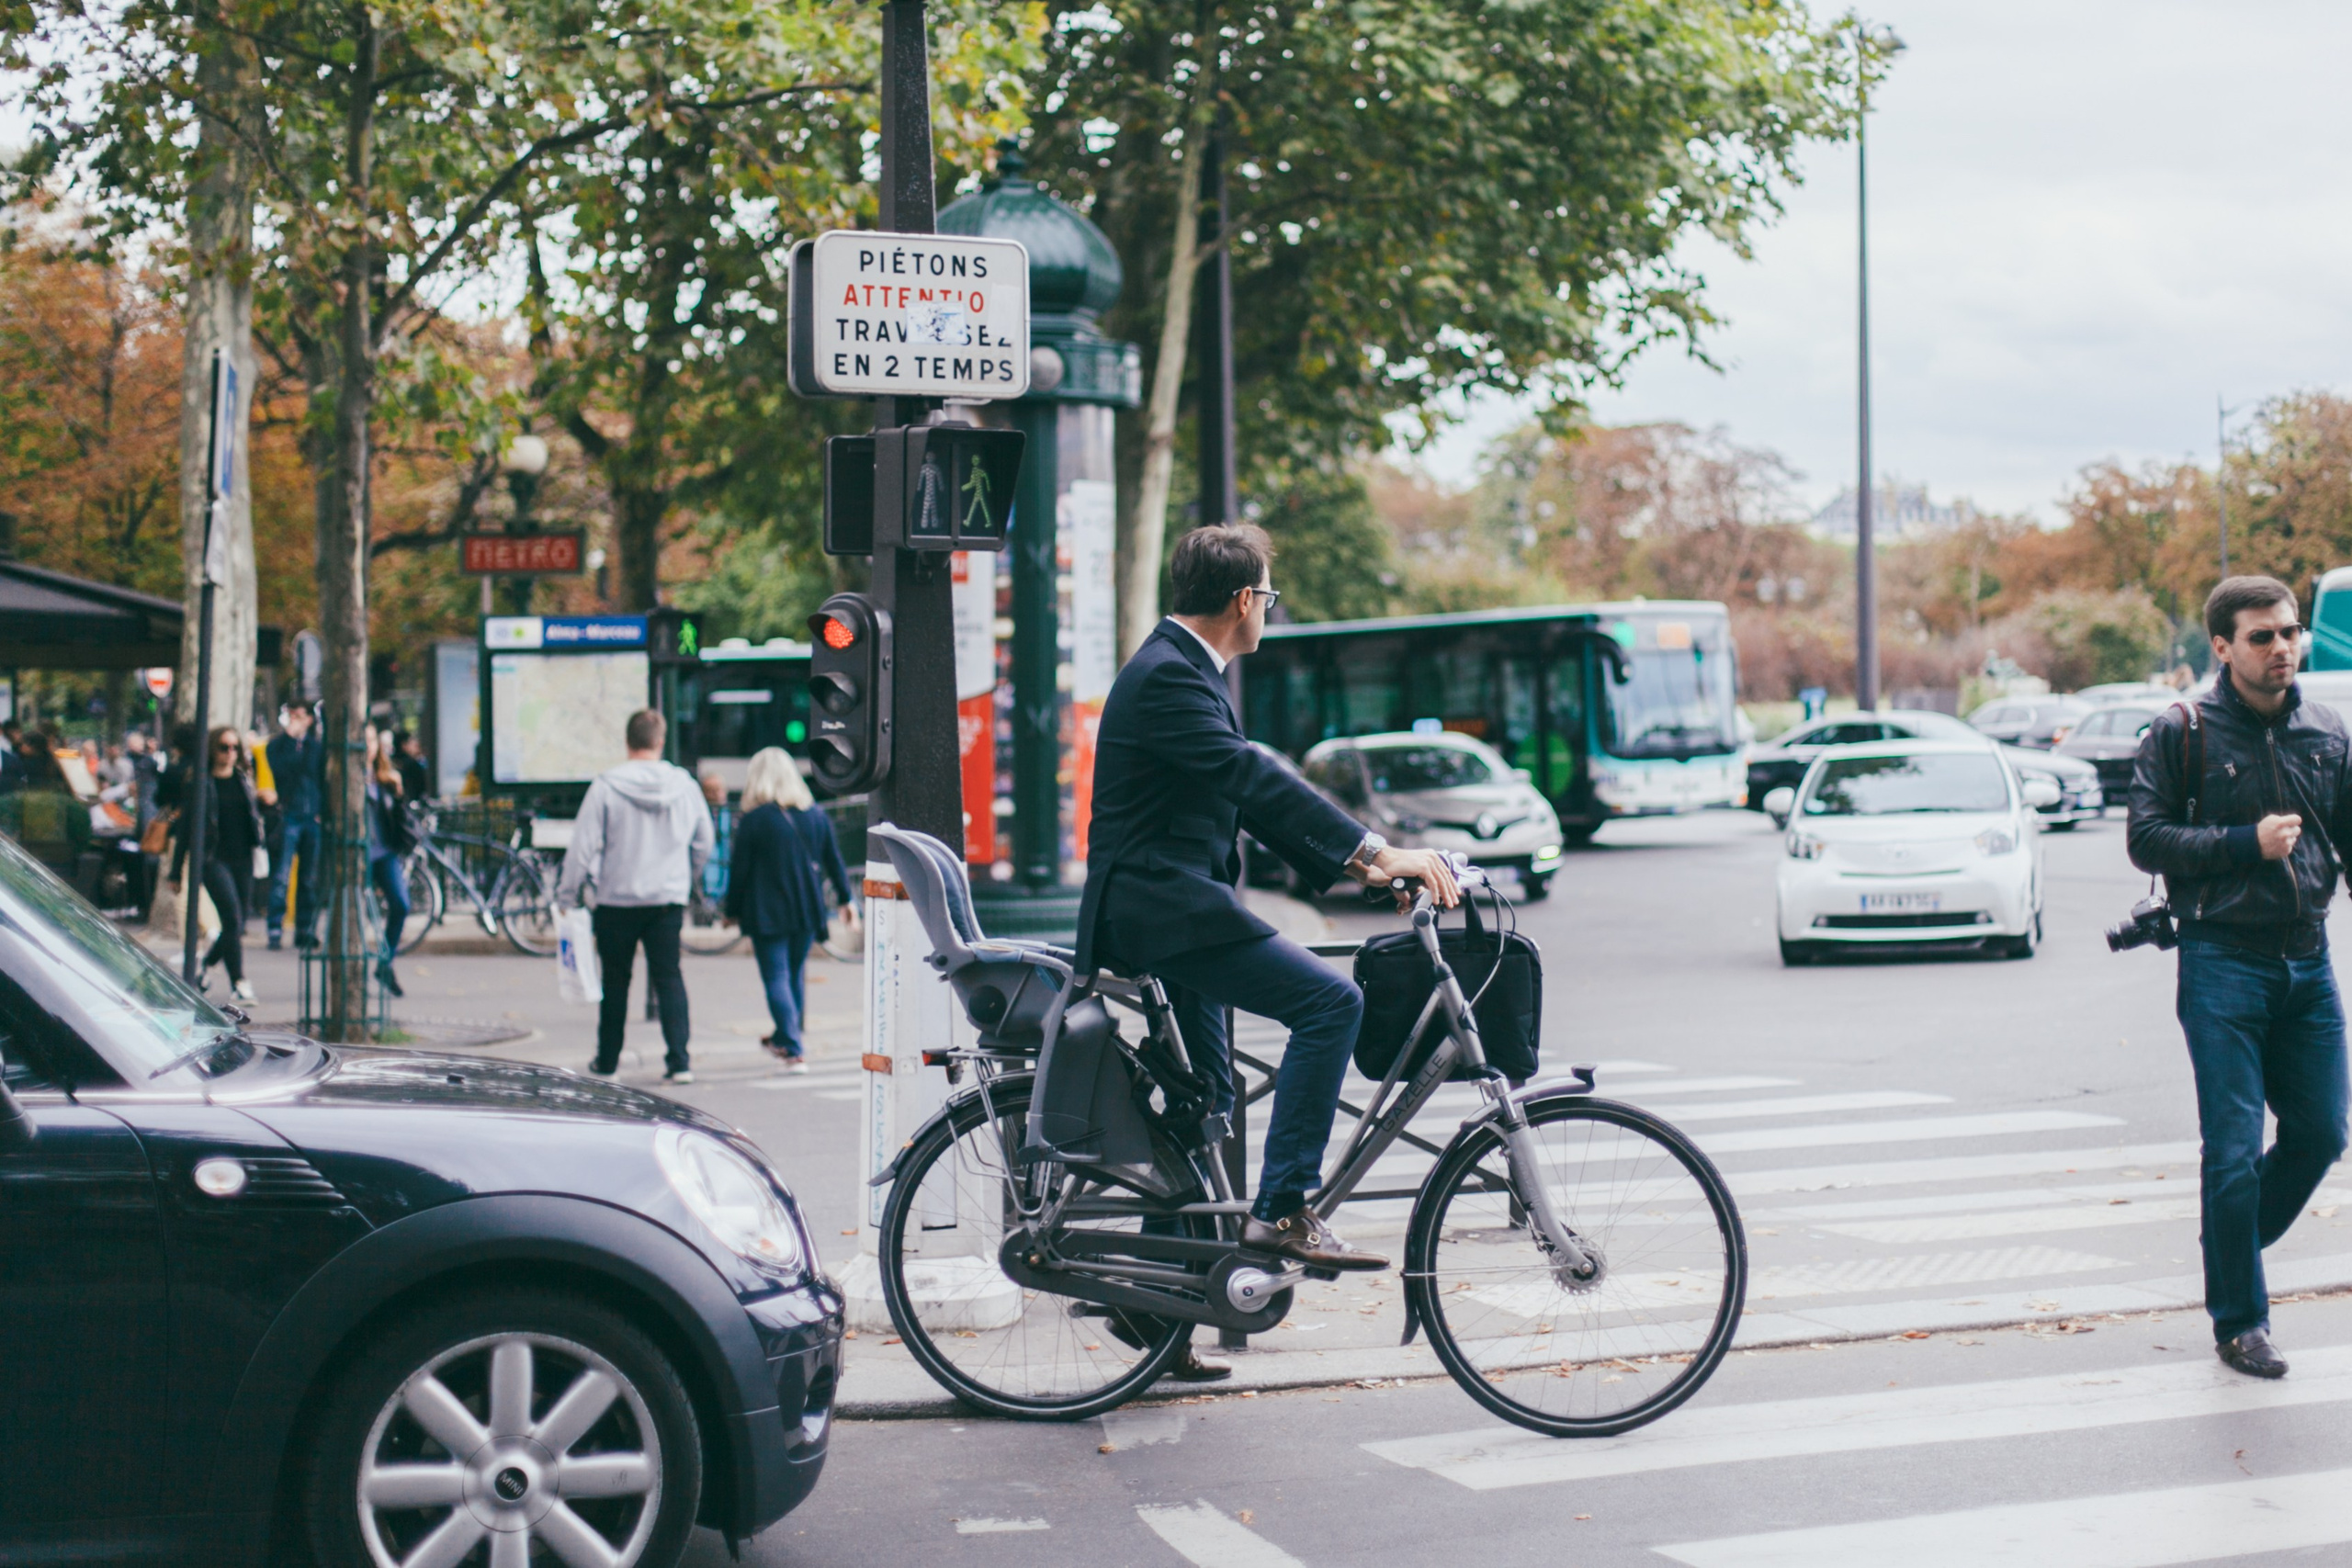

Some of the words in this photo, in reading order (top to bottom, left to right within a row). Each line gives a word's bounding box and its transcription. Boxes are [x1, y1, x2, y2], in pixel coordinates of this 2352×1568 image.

[860, 247, 988, 278] PIÉTONS
[843, 284, 984, 313] ATTENTIO
[836, 319, 1012, 347] TRAVSE
[834, 354, 870, 377] EN
[885, 355, 899, 378] 2
[914, 356, 1013, 382] TEMPS
[1380, 1054, 1447, 1133] GAZELLE
[500, 1472, 524, 1495] MINI
